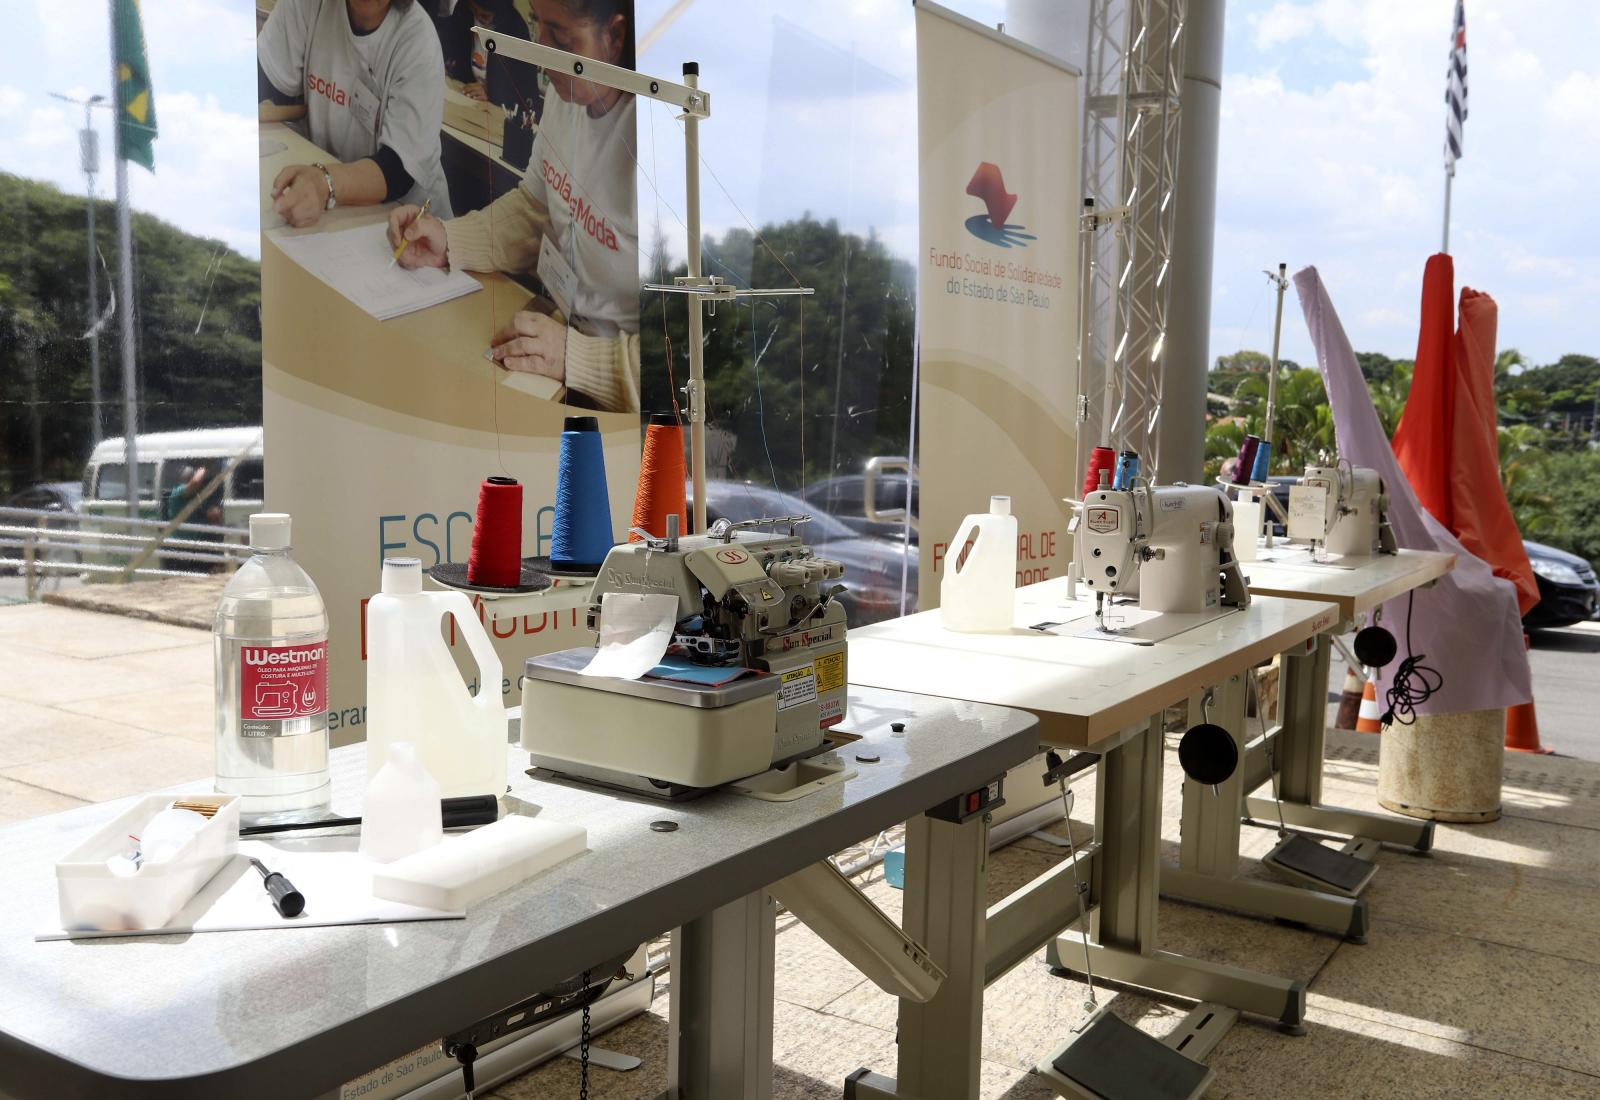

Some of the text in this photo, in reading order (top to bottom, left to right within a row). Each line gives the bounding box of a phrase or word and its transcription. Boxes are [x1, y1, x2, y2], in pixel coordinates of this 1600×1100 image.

[308, 73, 346, 107] scola
[543, 159, 618, 251] scola Moda
[929, 247, 1062, 289] Fundo Social de Solidariedade
[946, 277, 960, 294] do
[962, 278, 994, 300] Estado
[996, 284, 1008, 302] de
[1027, 289, 1050, 309] Paulo
[1041, 531, 1056, 558] DE
[783, 627, 832, 652] Sun Special
[246, 647, 324, 666] Westman
[343, 1079, 379, 1100] Estado
[381, 1072, 394, 1085] de
[396, 1063, 414, 1078] São
[416, 1051, 442, 1069] Paulo
